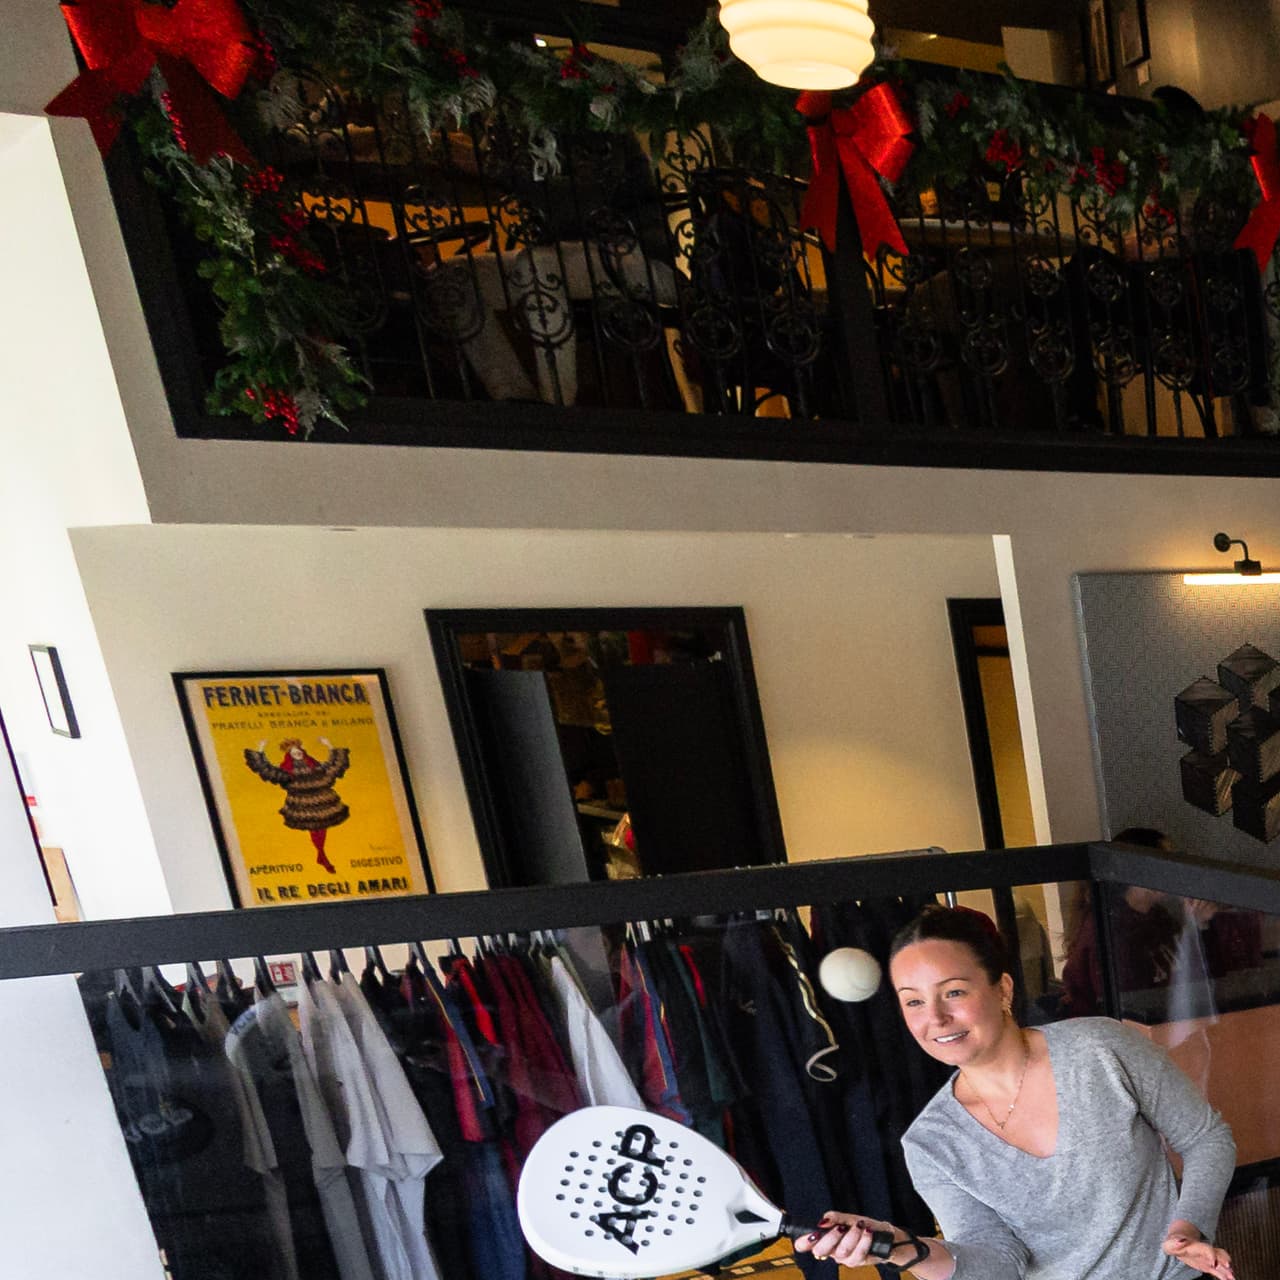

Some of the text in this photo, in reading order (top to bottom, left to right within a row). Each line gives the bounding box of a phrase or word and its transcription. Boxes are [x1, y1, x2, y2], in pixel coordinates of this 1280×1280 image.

[202, 683, 371, 708] FERNET-BRANCA
[270, 719, 318, 729] BRANCA
[331, 717, 374, 727] MILANO
[350, 855, 404, 868] DIGESTIVO
[256, 876, 408, 903] IL RE DEGLI AMARI
[594, 1123, 666, 1257] ACP
